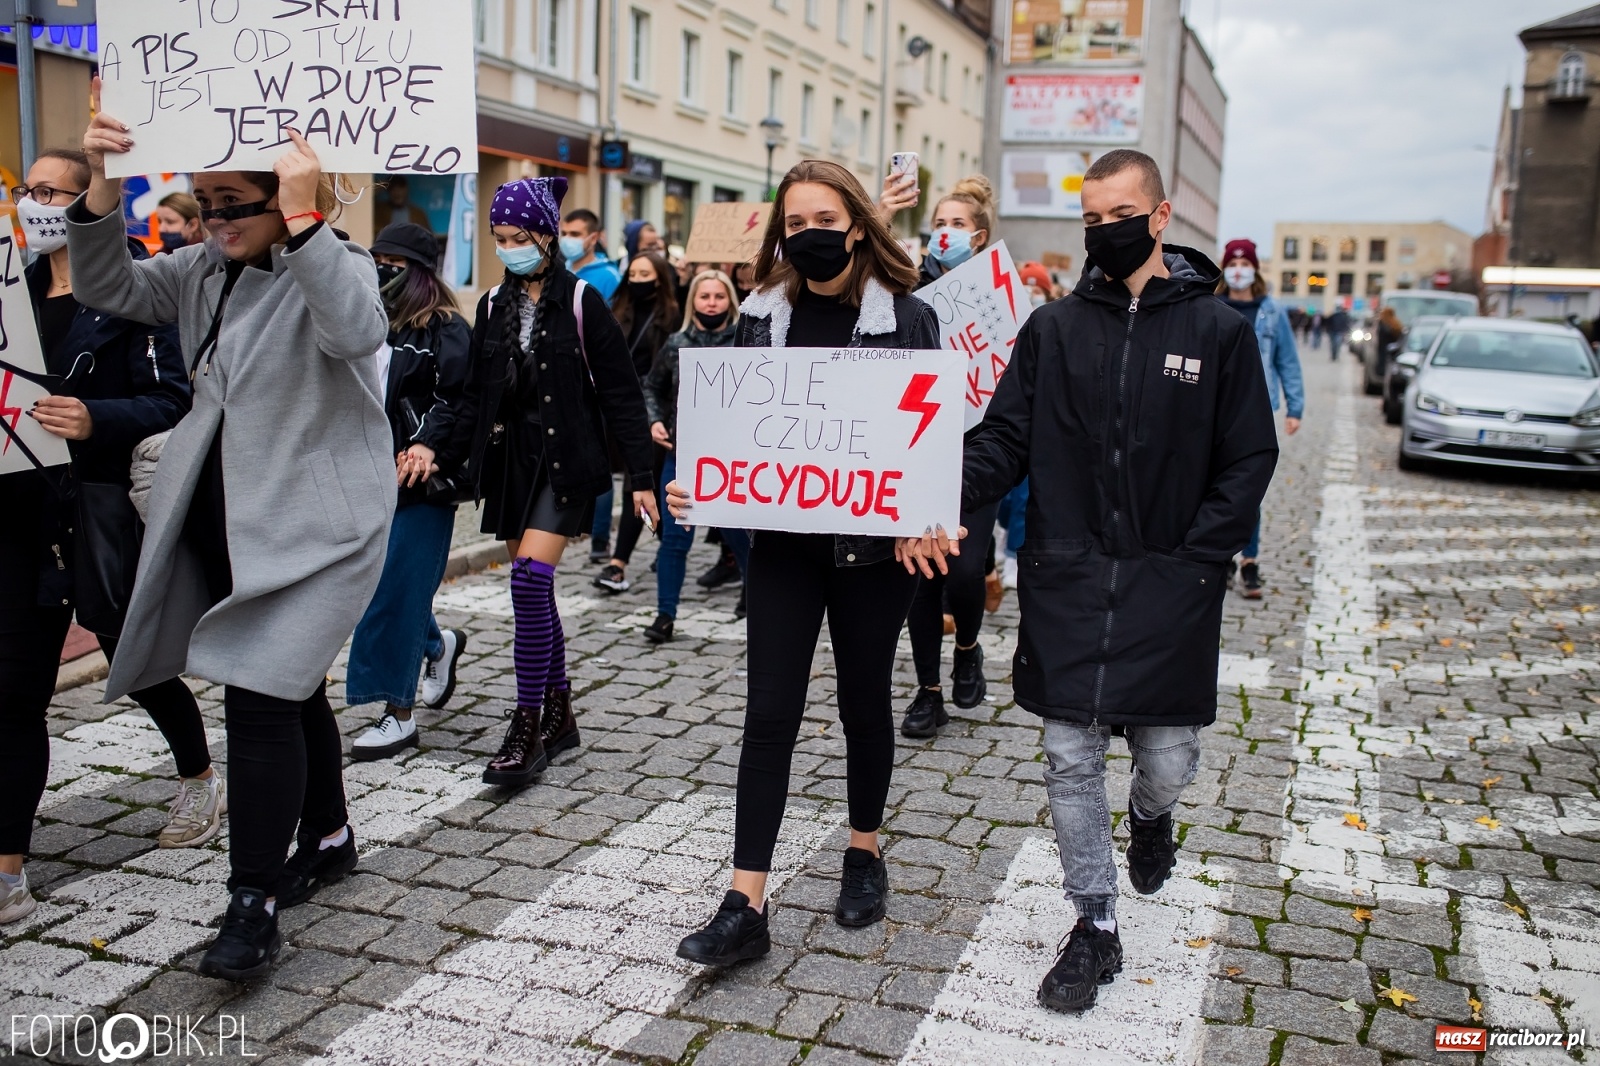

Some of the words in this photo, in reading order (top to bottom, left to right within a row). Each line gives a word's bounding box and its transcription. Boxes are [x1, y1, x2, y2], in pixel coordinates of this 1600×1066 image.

[100, 42, 122, 81] A
[131, 32, 199, 75] PIS
[233, 28, 292, 63] OD
[137, 66, 236, 127] JEST
[254, 61, 294, 103] W
[302, 65, 443, 115] DUPĘ
[203, 106, 397, 169] JEBANY
[385, 144, 461, 173] ELO
[693, 353, 828, 410] MYŚLĘ
[753, 414, 870, 459] CZUJĘ
[694, 456, 903, 522] DECYDUJĘ
